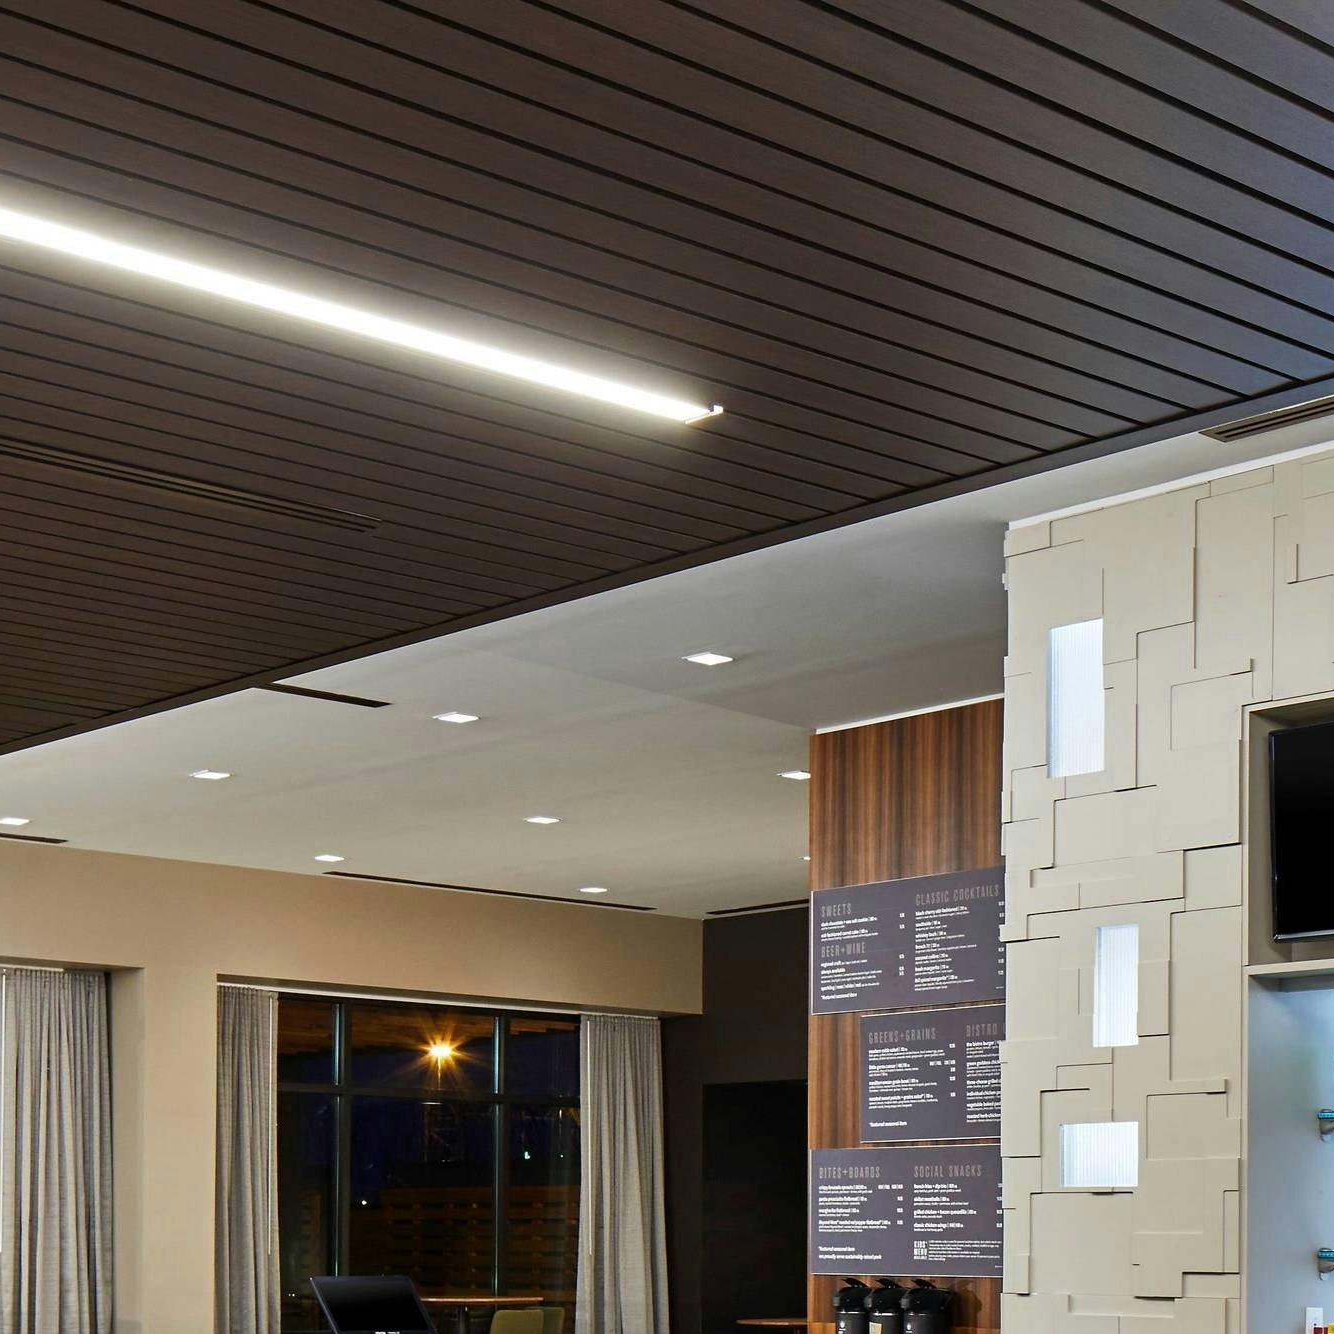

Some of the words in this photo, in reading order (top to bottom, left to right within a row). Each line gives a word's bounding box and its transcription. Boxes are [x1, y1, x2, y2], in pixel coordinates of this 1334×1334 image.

[915, 890, 949, 906] CLASSIC
[953, 884, 1000, 902] COCKTAILS
[821, 903, 852, 918] SWEETS
[821, 942, 866, 958] BEER+WINE
[868, 1027, 936, 1044] GREENS+GRAINS
[966, 1023, 998, 1037] BISTRO
[819, 1166, 880, 1179] BITES+BOARDS
[914, 1165, 944, 1178] SOCIAL
[948, 1164, 982, 1177] SNACKS
